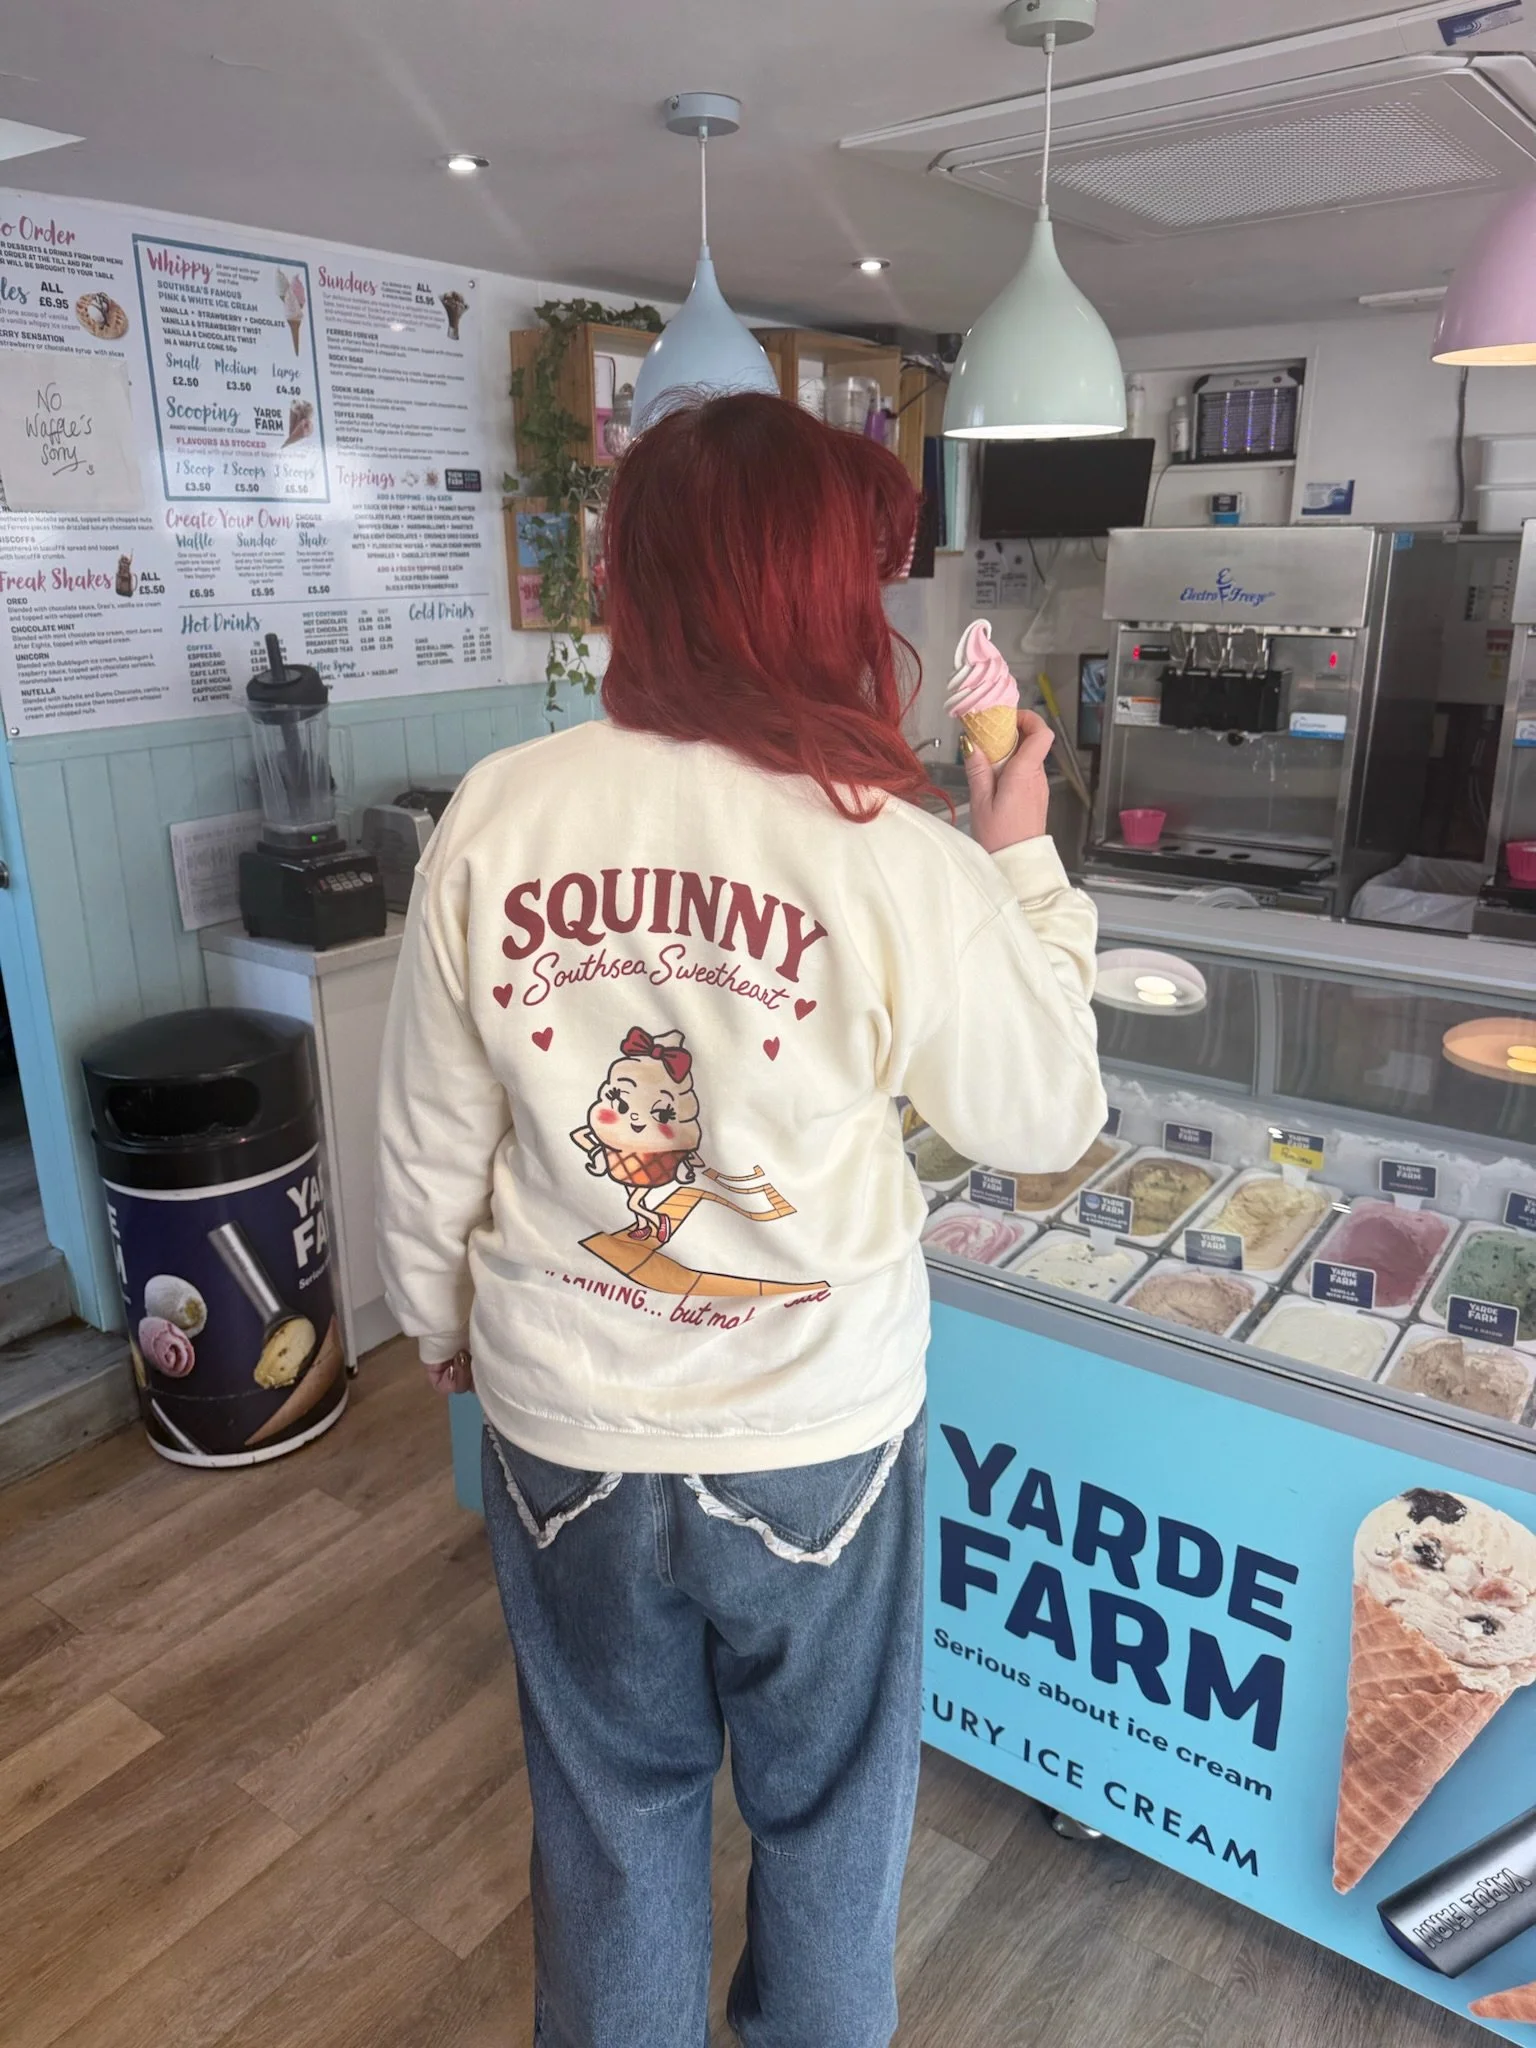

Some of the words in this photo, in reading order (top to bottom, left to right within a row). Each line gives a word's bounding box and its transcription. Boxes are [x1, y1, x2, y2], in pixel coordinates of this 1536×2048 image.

[20, 215, 76, 246] Order
[147, 248, 214, 284] Whippy
[41, 281, 63, 294] ALL
[318, 265, 378, 297] Sundaes
[417, 282, 431, 293] ALL
[157, 280, 209, 295] SOUTHSEA'S
[210, 288, 242, 300] FAMOUS
[39, 297, 69, 310] £6.95
[158, 292, 179, 303] PINK
[181, 295, 187, 303] &
[188, 296, 213, 307] WHITE
[215, 299, 228, 309] ICE
[231, 301, 258, 313] CREAM
[415, 294, 435, 307] £5.95
[160, 306, 189, 317] VANILLA
[198, 310, 242, 323] STRAWBERRY
[250, 316, 285, 329] CHOCOLATE
[161, 316, 191, 328] VANILLA
[197, 321, 241, 334] STRAWBERRY
[242, 326, 261, 337] TWIST
[21, 331, 65, 344] SENSATION
[163, 327, 192, 339] VANILLA
[198, 332, 236, 344] CHOCOLATE
[237, 335, 257, 346] TWIST
[164, 337, 172, 346] IN
[179, 339, 206, 351] WAFFLE
[166, 351, 202, 371] Small
[214, 357, 259, 376] Medium
[272, 361, 302, 383] Large
[173, 376, 199, 388] £2.50
[226, 381, 252, 392] £3.50
[276, 385, 301, 396] £4.50
[37, 382, 62, 413] NO
[166, 396, 241, 427] Scooping
[26, 413, 93, 445] Waffle's
[255, 418, 284, 432] FARM
[176, 436, 218, 449] FLAVOURS
[231, 440, 266, 450] STOCKED
[183, 459, 216, 477] Scoop
[231, 463, 266, 479] Scoops
[336, 465, 395, 490] Toppings
[185, 482, 211, 493] £3.50
[235, 483, 260, 494] £5.50
[165, 507, 217, 529] Create
[218, 508, 254, 530] Your
[258, 508, 292, 530] Own
[175, 532, 215, 550] Waffle
[237, 532, 277, 548] Sundae
[298, 532, 329, 548] Shake
[0, 569, 46, 592] Freak
[51, 567, 113, 593] Shakes
[141, 572, 160, 582] ALL
[139, 585, 165, 596] £5.50
[189, 588, 215, 599] £6.95
[251, 588, 275, 598] £5.95
[308, 585, 330, 595] £5.50
[1180, 586, 1218, 603] Electro
[7, 598, 28, 606] OREO
[409, 602, 434, 621] Cold
[438, 601, 475, 620] Drinks
[11, 625, 56, 634] CHOCOLATE
[58, 624, 75, 632] MINT
[181, 613, 211, 634] Hot
[214, 612, 261, 633] Drinks
[187, 643, 213, 652] COFFEE
[16, 652, 50, 662] UNICORN
[188, 652, 222, 661] ESPRESSO
[189, 660, 226, 669] AMERICANO
[190, 669, 207, 678] CAFE
[208, 668, 228, 677] LATTE
[191, 678, 209, 687] CAFE
[192, 685, 233, 695] CAPPUCCINO
[21, 688, 56, 697] NUTELLA
[193, 694, 209, 703] FLAT
[502, 867, 829, 983] SQUINNY
[523, 948, 648, 1007] Southsea
[649, 943, 791, 1010] Sweetheart
[1396, 1170, 1422, 1180] FARM
[1101, 1204, 1124, 1215] FARM
[1330, 1274, 1357, 1288] FARM
[670, 1295, 712, 1326] but
[1468, 1310, 1498, 1325] FARM
[1469, 1303, 1498, 1316] YARDE
[940, 1424, 1299, 1642] YARDE
[940, 1516, 1286, 1752] FARM
[934, 1628, 1031, 1688] Serious
[1037, 1680, 1119, 1731] about
[1127, 1717, 1169, 1753] ice
[1175, 1745, 1274, 1802] cream
[1022, 1738, 1086, 1790] ICE
[1103, 1780, 1261, 1879] CREAM
[1461, 1867, 1532, 1917] YARDE
[1412, 1901, 1475, 1951] FARM
